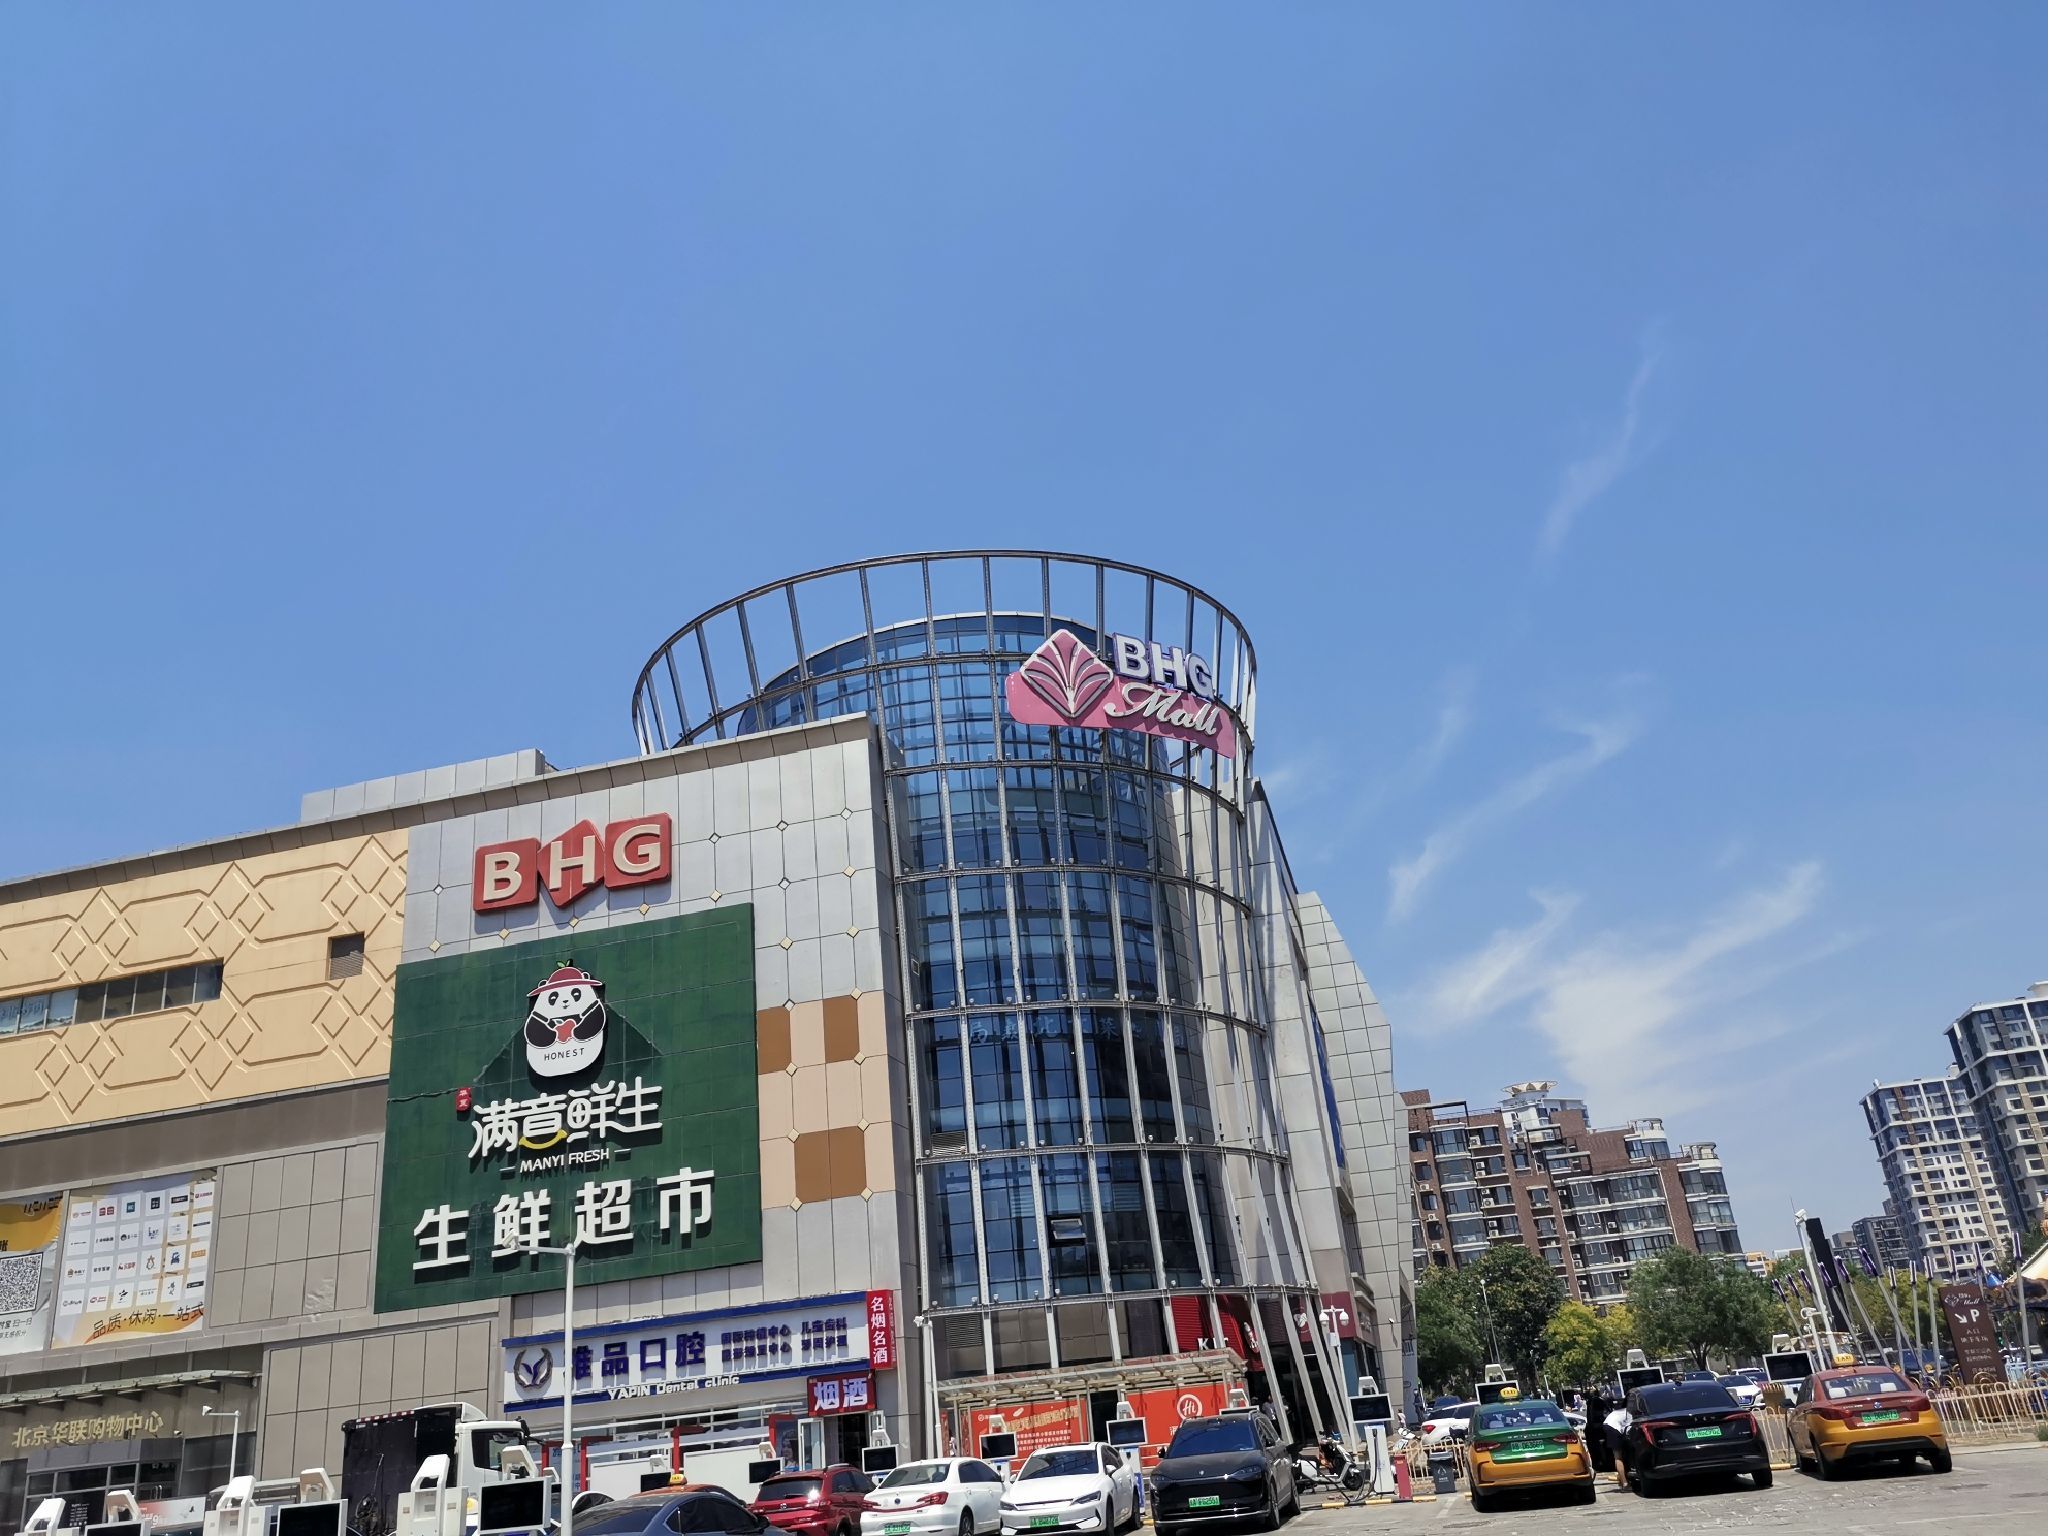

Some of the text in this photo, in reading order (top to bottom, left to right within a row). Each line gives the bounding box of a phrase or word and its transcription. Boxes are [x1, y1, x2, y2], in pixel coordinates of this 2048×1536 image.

[1112, 632, 1215, 700] BHG
[1103, 682, 1216, 736] Mall
[483, 824, 661, 903] BHG
[544, 1048, 585, 1061] HONEST
[468, 1076, 663, 1158] 满意鲜生
[520, 1148, 610, 1173] MANYI FRESH
[412, 1167, 714, 1270] 生鲜超市
[871, 1297, 888, 1364] 名烟名酒
[1970, 1309, 1980, 1322] P
[607, 1375, 740, 1400] YAPIN Dental clinic
[814, 1377, 868, 1411] 烟酒
[1183, 1399, 1197, 1416] Hi
[12, 1410, 164, 1448] 北京华联购物中心
